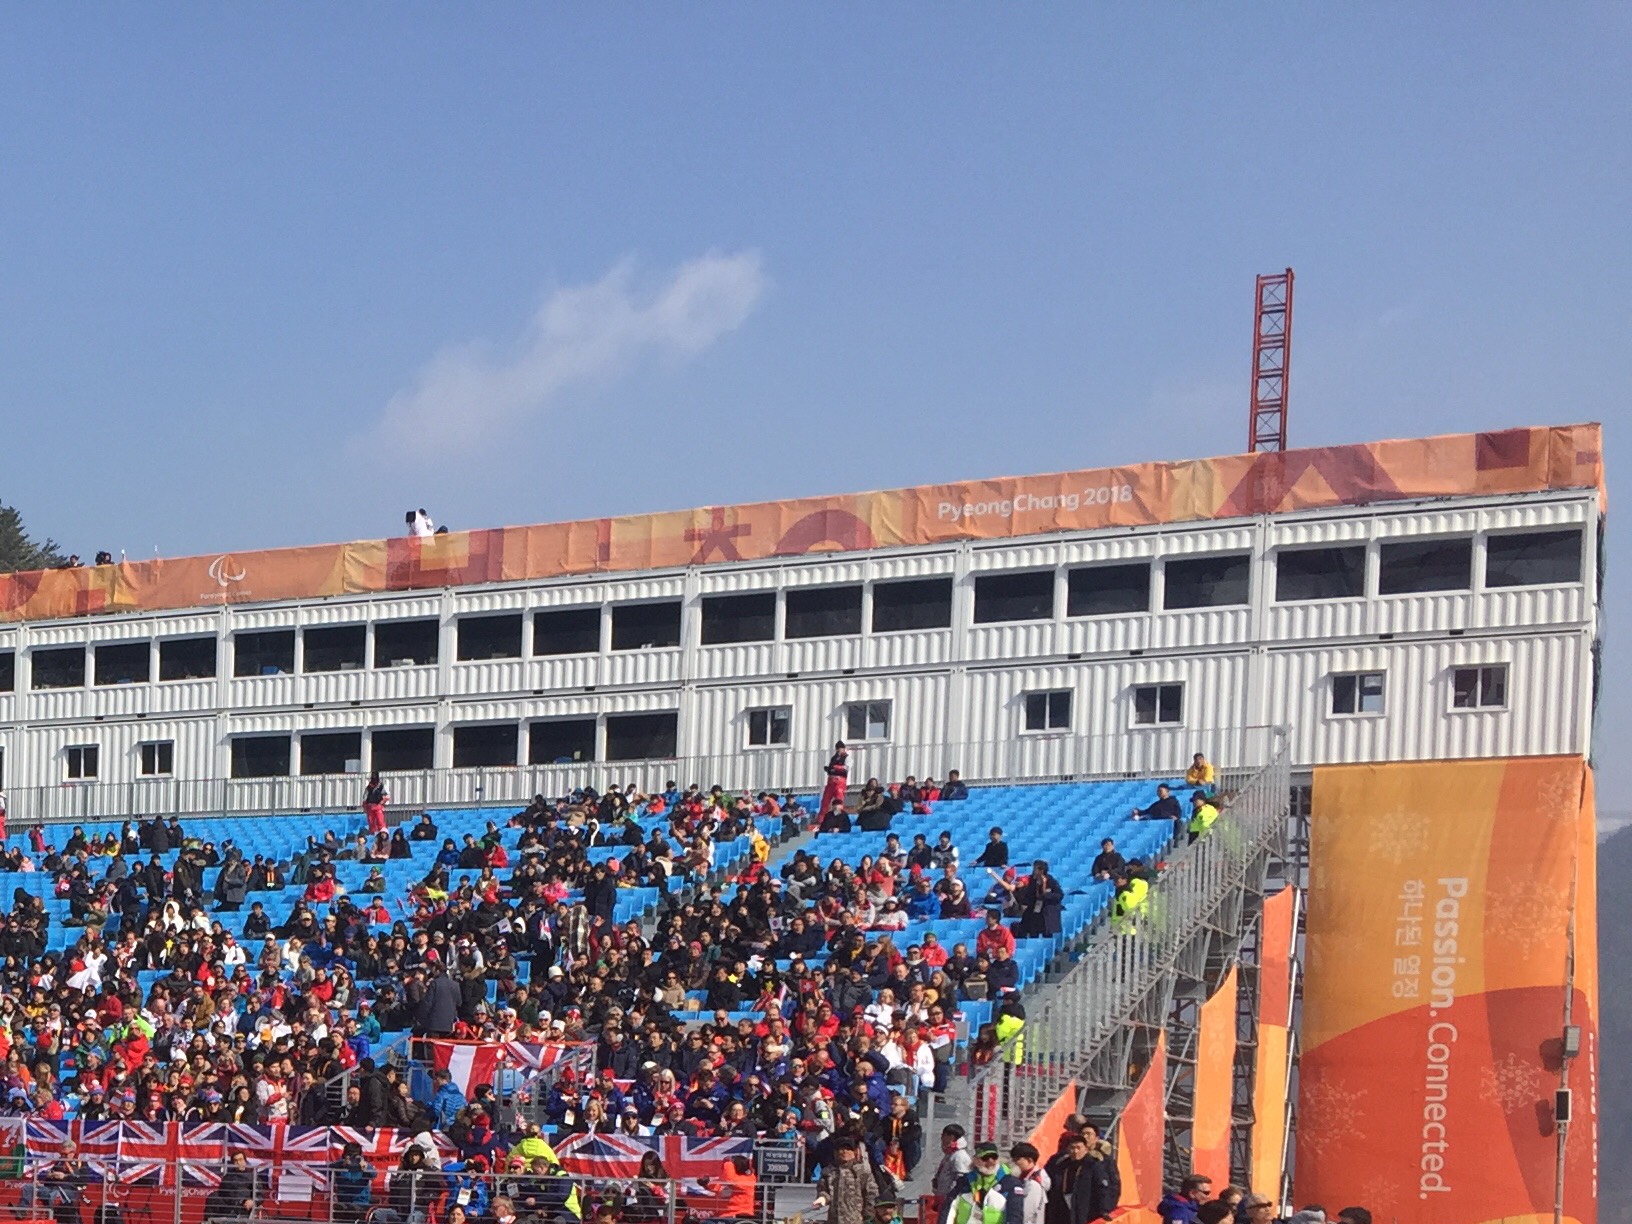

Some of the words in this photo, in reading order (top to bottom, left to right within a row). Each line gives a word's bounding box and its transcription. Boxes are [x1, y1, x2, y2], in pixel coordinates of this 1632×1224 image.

[938, 493, 1080, 522] PyeongChang
[1084, 484, 1133, 506] 2018
[1429, 877, 1469, 1017] Passion.
[1419, 1021, 1458, 1200] Connected.
